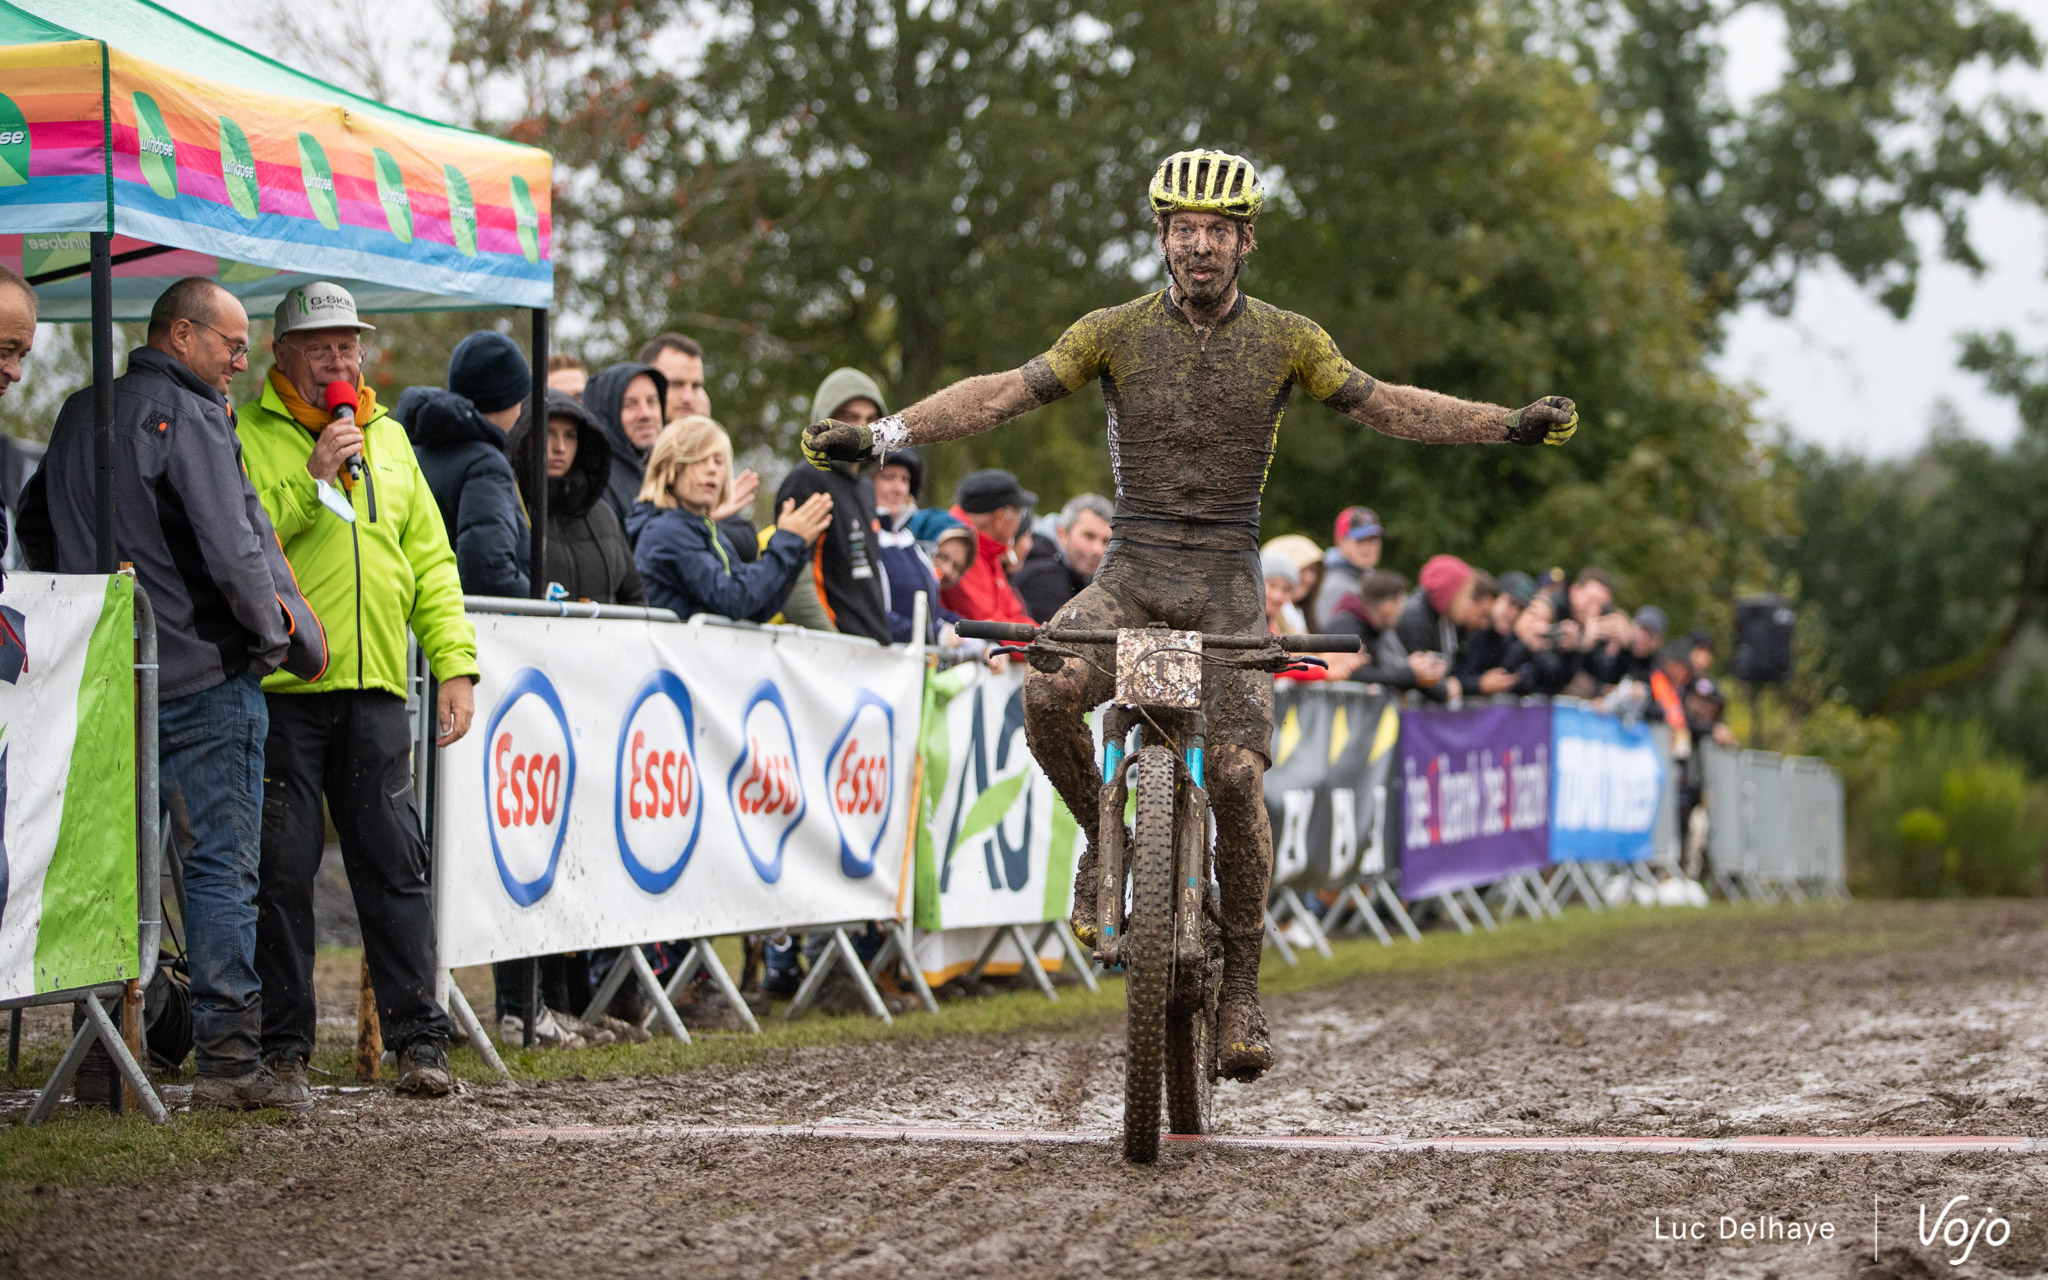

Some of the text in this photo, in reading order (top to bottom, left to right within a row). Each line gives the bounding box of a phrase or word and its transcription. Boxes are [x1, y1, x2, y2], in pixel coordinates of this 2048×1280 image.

[141, 136, 174, 157] windose
[495, 732, 561, 828] Esso
[629, 730, 693, 820] Esso
